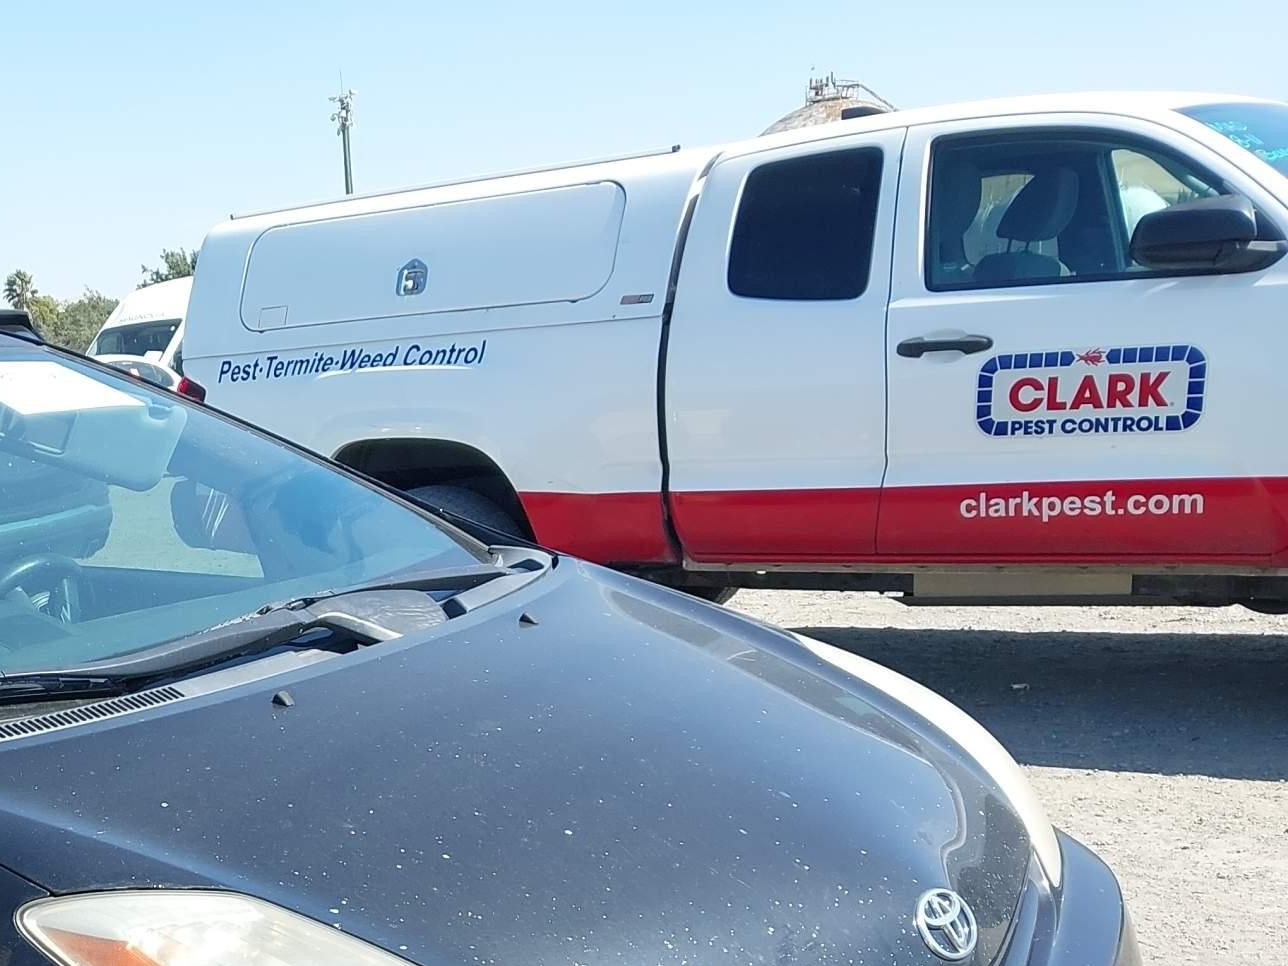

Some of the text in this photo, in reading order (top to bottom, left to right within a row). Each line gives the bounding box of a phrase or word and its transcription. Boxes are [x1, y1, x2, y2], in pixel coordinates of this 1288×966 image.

[403, 339, 487, 366] Control
[1008, 371, 1172, 413] CLARK
[1011, 415, 1164, 436] PEST CONTROL
[960, 490, 1204, 522] clarkpest.com
